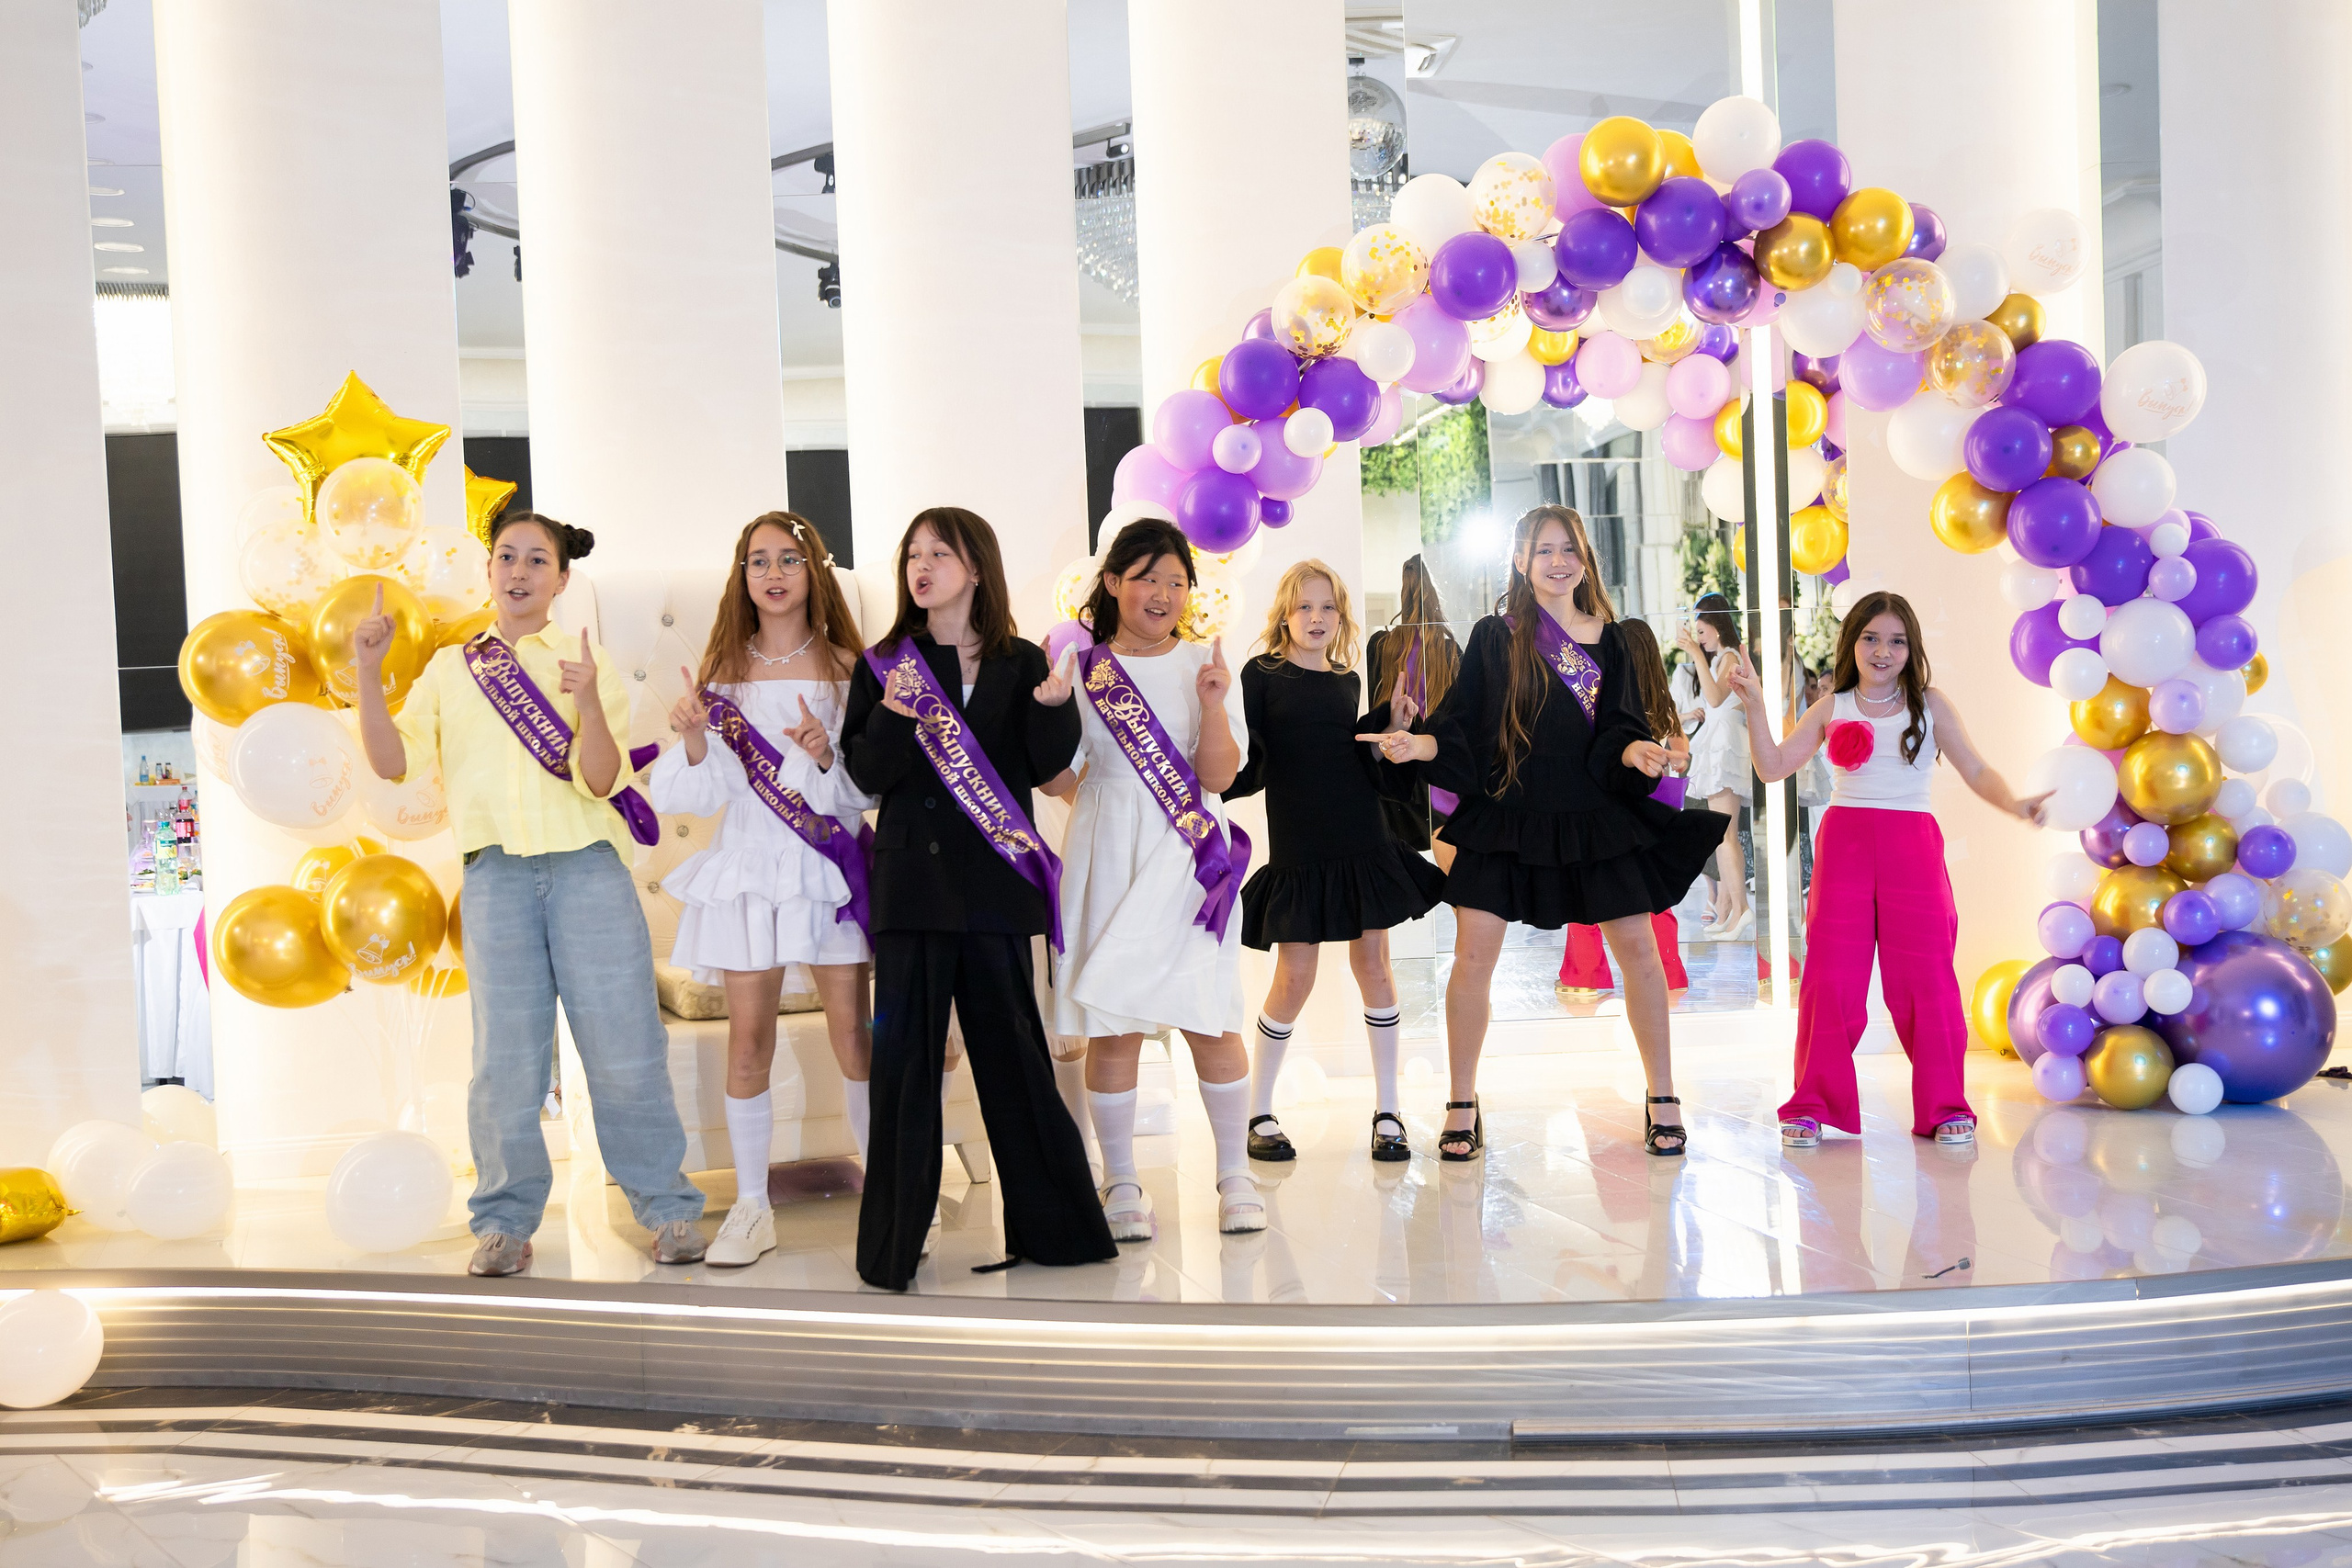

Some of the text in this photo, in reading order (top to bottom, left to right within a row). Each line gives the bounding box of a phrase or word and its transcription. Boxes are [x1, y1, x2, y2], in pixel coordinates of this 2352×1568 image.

[261, 626, 296, 700] Выпуск!
[478, 645, 571, 757] Выпускник
[515, 720, 557, 768] школы
[753, 778, 796, 822] школы
[912, 694, 1012, 824] Выпускник
[914, 722, 997, 835] чальной школы
[1095, 698, 1180, 818] начальной школы
[1105, 684, 1193, 807] Выпускник
